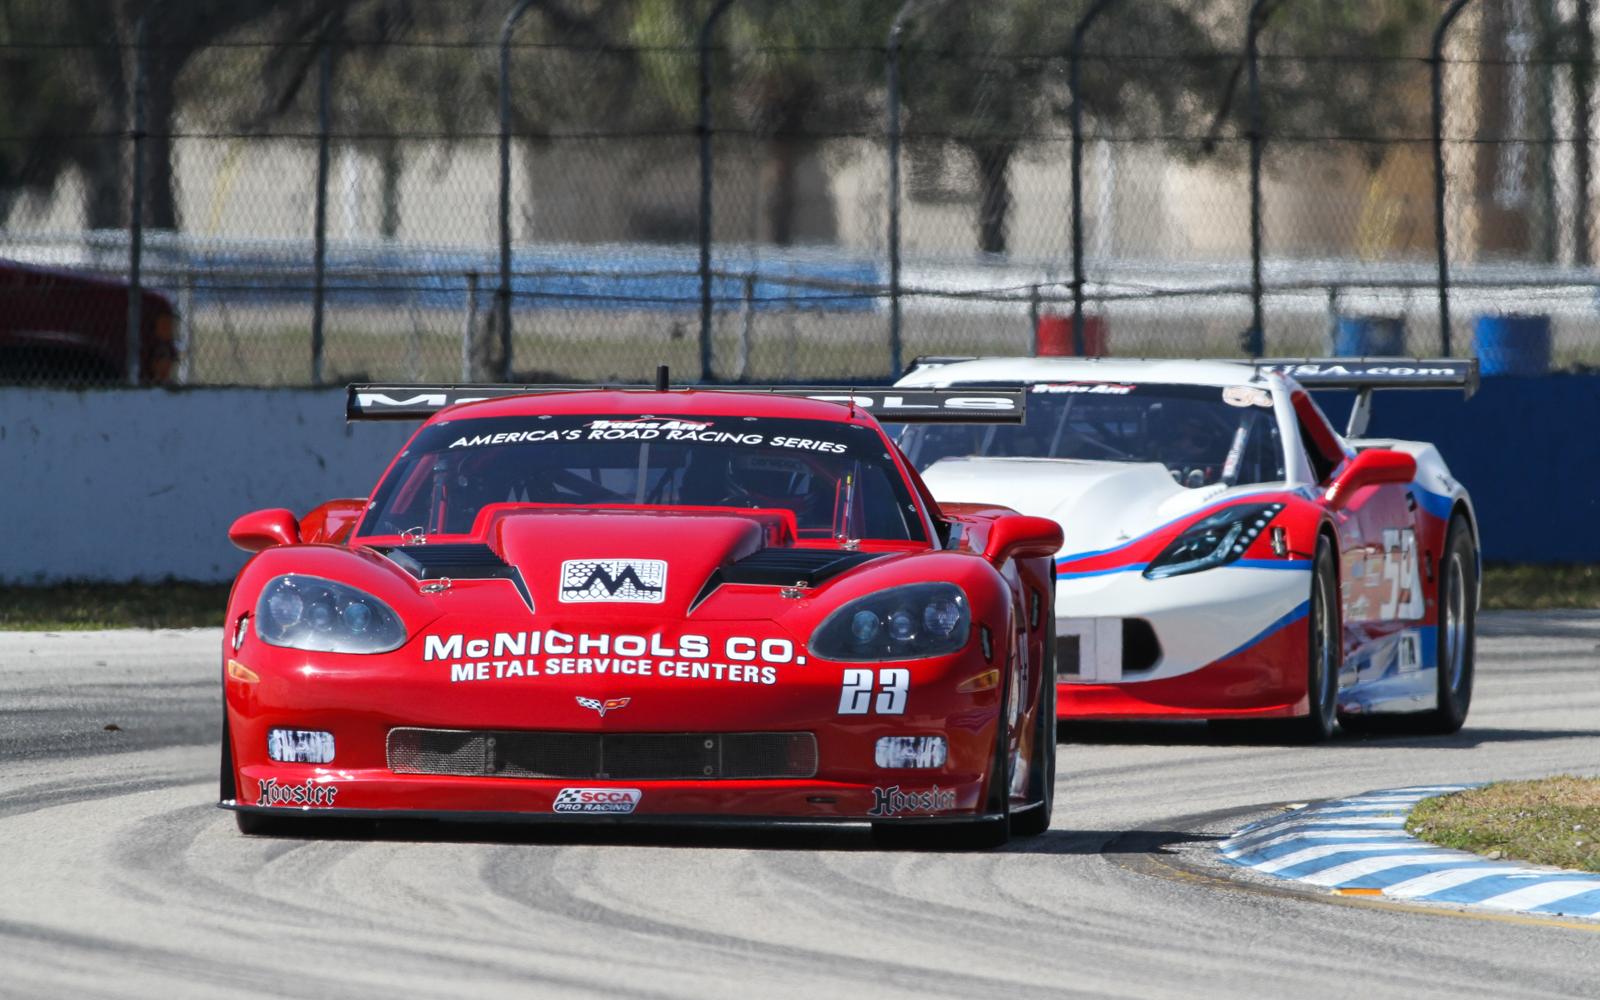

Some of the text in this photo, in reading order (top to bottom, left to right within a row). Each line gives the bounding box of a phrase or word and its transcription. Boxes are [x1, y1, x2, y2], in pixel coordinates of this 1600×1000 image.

[589, 420, 707, 431] Trans Am
[449, 428, 848, 454] AMERICA'S ROAD RACING SERIES
[422, 629, 808, 666] McNICHOLS CO.
[450, 657, 778, 686] METAL SERVICE CENTERS
[836, 667, 911, 716] 23
[255, 776, 339, 807] Hoosier
[580, 791, 635, 804] SCCA
[866, 785, 957, 816] Hoosier
[556, 803, 633, 811] PRO RACING
